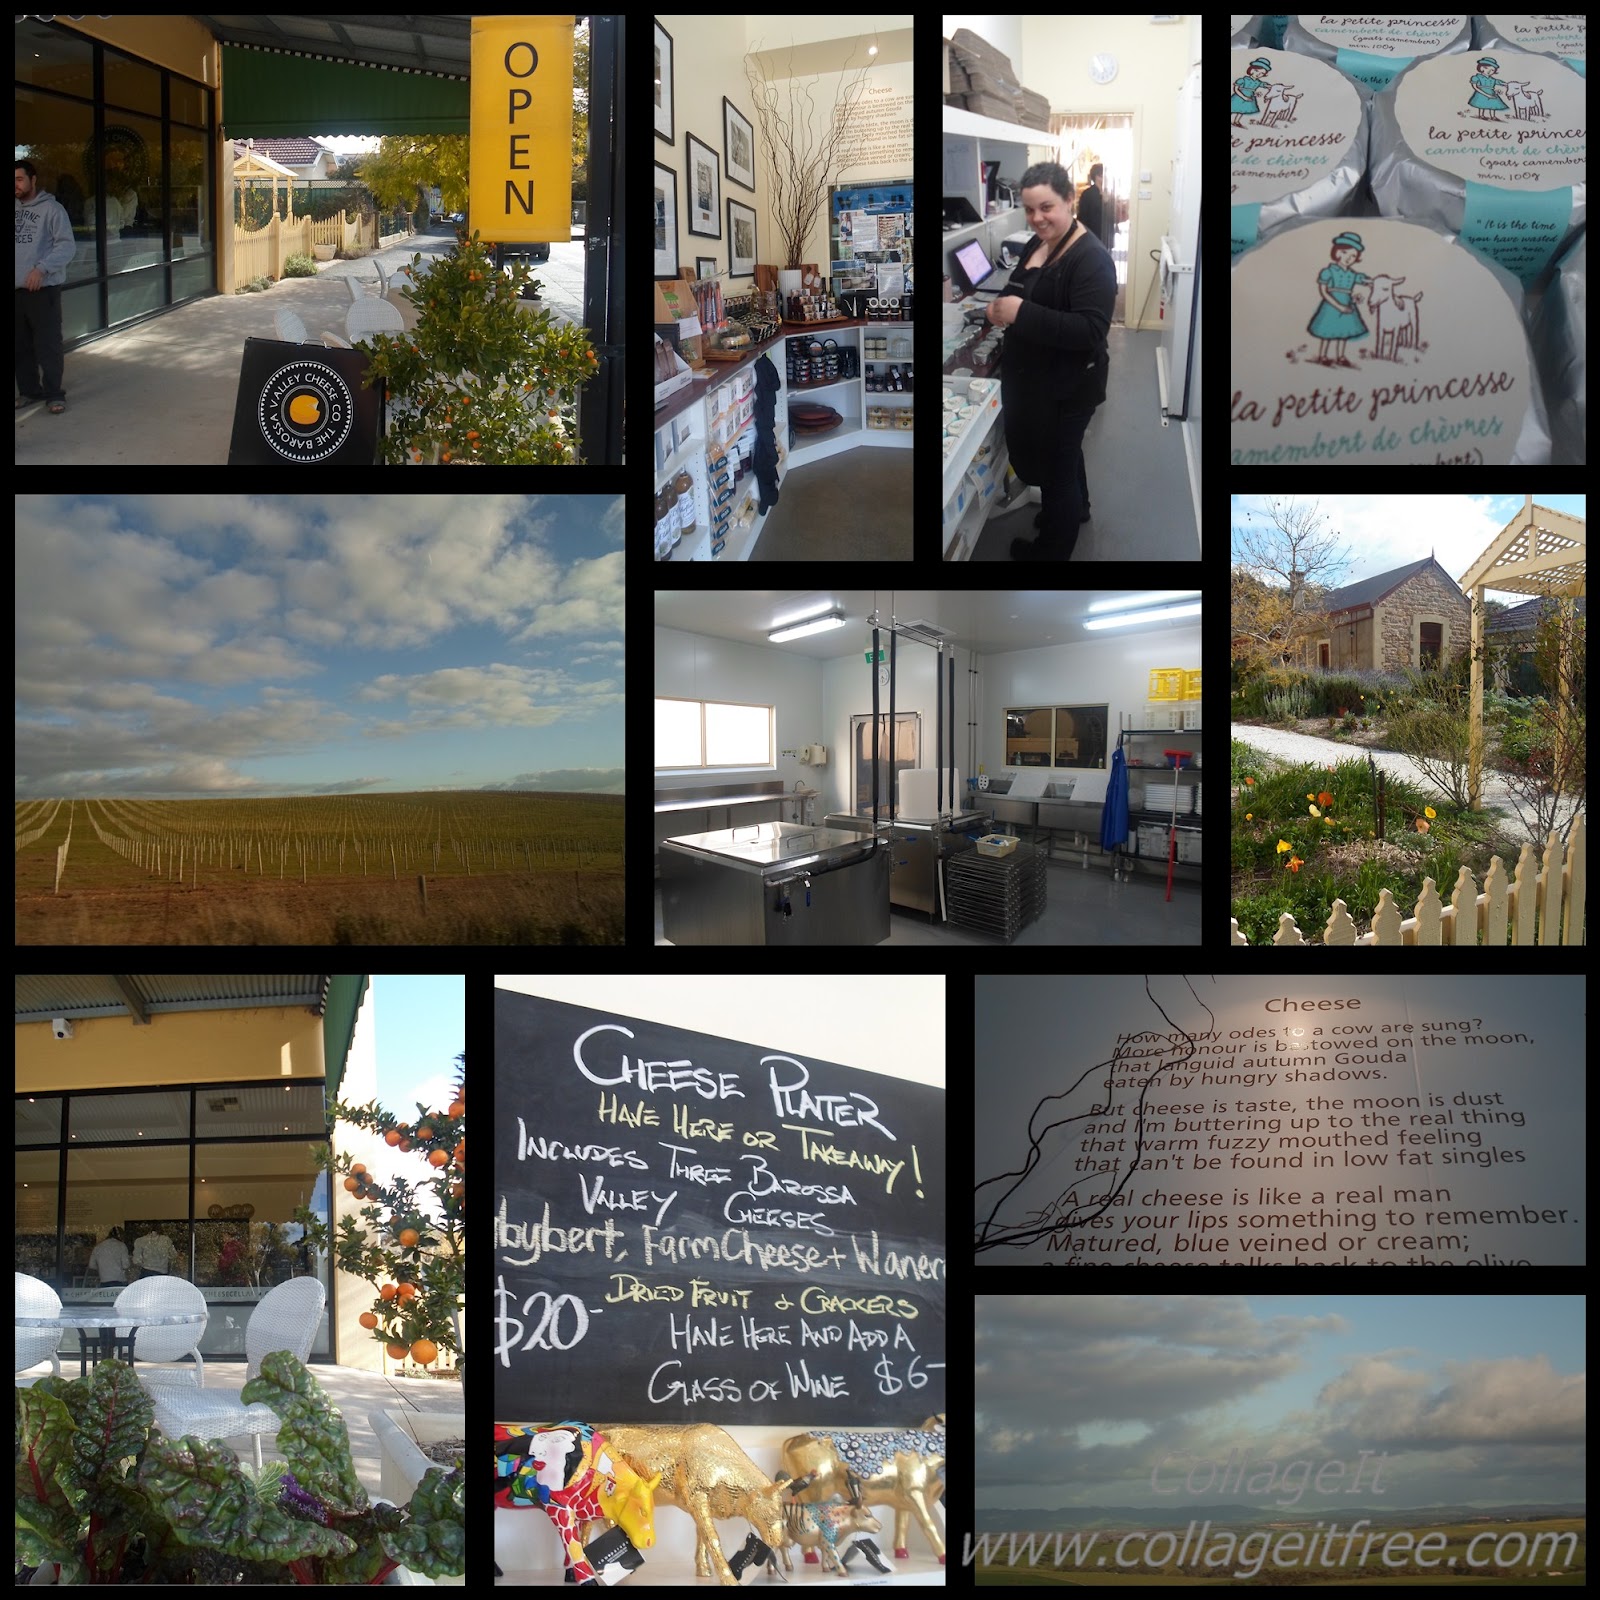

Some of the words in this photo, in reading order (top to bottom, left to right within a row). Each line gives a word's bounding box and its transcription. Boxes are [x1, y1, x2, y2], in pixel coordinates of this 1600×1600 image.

[1341, 16, 1385, 26] petite
[1387, 17, 1460, 27] princesse
[1535, 24, 1573, 34] petite
[504, 42, 538, 215] OPEN
[1428, 126, 1451, 140] la
[1456, 128, 1513, 142] petite
[1245, 133, 1345, 153] princesse
[1424, 144, 1519, 156] camembert
[1522, 145, 1541, 156] de
[1241, 155, 1260, 165] de
[1267, 154, 1328, 166] chèvres
[1509, 171, 1540, 181] 100g
[270, 373, 300, 408] VALLEY
[305, 373, 339, 401] CHEESE
[1272, 385, 1363, 428] petite
[1369, 371, 1515, 421] princesse
[270, 413, 313, 449] BAROSSA
[315, 428, 336, 446] THE
[1372, 425, 1402, 451] de
[1410, 415, 1504, 444] chèvres
[1265, 997, 1361, 1013] Cheese
[1112, 1046, 1164, 1058] More
[1254, 1040, 1267, 1053] is
[1387, 1037, 1413, 1048] on
[1420, 1033, 1456, 1047] the
[1465, 1031, 1535, 1046] moon,
[1116, 1033, 1160, 1045] How
[1167, 1030, 1222, 1044] many
[1229, 1027, 1276, 1040] odes
[1312, 1026, 1323, 1036] a
[1332, 1023, 1373, 1035] cow
[1381, 1022, 1414, 1034] are
[1421, 1018, 1483, 1034] sung?
[573, 1023, 745, 1100] CHEESE
[1110, 1059, 1151, 1073] that
[1158, 1057, 1235, 1073] languid
[1243, 1054, 1326, 1069] autumn
[1335, 1050, 1407, 1065] Gouda
[1103, 1075, 1161, 1089] eaten
[1169, 1073, 1195, 1089] by
[1201, 1071, 1278, 1088] hungry
[1285, 1068, 1388, 1083] shadows.
[1090, 1103, 1125, 1117] But
[1132, 1101, 1205, 1116] cheese
[1213, 1100, 1227, 1114] is
[1235, 1099, 1296, 1115] taste,
[1306, 1096, 1344, 1111] the
[1353, 1096, 1420, 1109] moon
[1429, 1093, 1445, 1107] is
[1453, 1091, 1504, 1106] dust
[598, 1090, 661, 1128] HAVE
[673, 1103, 736, 1142] HERE
[742, 1131, 780, 1151] OR
[1084, 1118, 1125, 1134] and
[1134, 1118, 1165, 1133] I'm
[1174, 1116, 1281, 1134] buttering
[1290, 1117, 1320, 1132] up
[1328, 1115, 1353, 1128] to
[1360, 1112, 1400, 1127] the
[1410, 1109, 1454, 1125] real
[1461, 1108, 1526, 1127] thing
[1080, 1138, 1126, 1152] that
[1134, 1137, 1198, 1151] warm
[1207, 1134, 1270, 1152] fuzzy
[1279, 1131, 1388, 1148] mouthed
[1397, 1129, 1482, 1147] feeling
[517, 1115, 649, 1171] INCLUDES
[659, 1141, 732, 1186] THREE
[740, 1154, 857, 1206] BAROSSA
[1074, 1156, 1120, 1172] that
[1129, 1154, 1184, 1172] can't
[1193, 1154, 1222, 1171] be
[1230, 1152, 1303, 1170] found
[1313, 1152, 1334, 1168] in
[1345, 1150, 1388, 1166] low
[1397, 1148, 1433, 1165] fat
[1442, 1146, 1526, 1168] singles
[579, 1172, 678, 1226] VALLEY
[724, 1191, 835, 1237] CHEESES
[1061, 1191, 1079, 1207] A
[1088, 1189, 1133, 1207] real
[1142, 1188, 1223, 1207] cheese
[1232, 1188, 1249, 1206] is
[1259, 1187, 1301, 1206] like
[1311, 1190, 1325, 1205] a
[1336, 1185, 1382, 1204] real
[1394, 1187, 1451, 1203] man
[1052, 1211, 1115, 1234] gives
[1121, 1215, 1180, 1234] your
[1187, 1210, 1228, 1233] lips
[1238, 1208, 1376, 1231] something
[1386, 1210, 1415, 1226] to
[1425, 1204, 1579, 1226] remember.
[1046, 1233, 1162, 1255] Matured,
[1174, 1233, 1229, 1252] blue
[1239, 1232, 1327, 1252] veined
[1339, 1236, 1366, 1251] or
[1377, 1234, 1470, 1252] cream;
[606, 1273, 683, 1305] DRIED
[689, 1276, 753, 1310] FRUIT
[800, 1286, 920, 1320] CRACKERS
[669, 1313, 734, 1354] HAVE
[741, 1315, 791, 1351] HERE
[801, 1318, 843, 1348] AND
[847, 1320, 889, 1352] ADD
[893, 1323, 915, 1352] A
[648, 1360, 742, 1406] GLASS
[749, 1378, 781, 1402] OF
[785, 1358, 850, 1400] WINE
